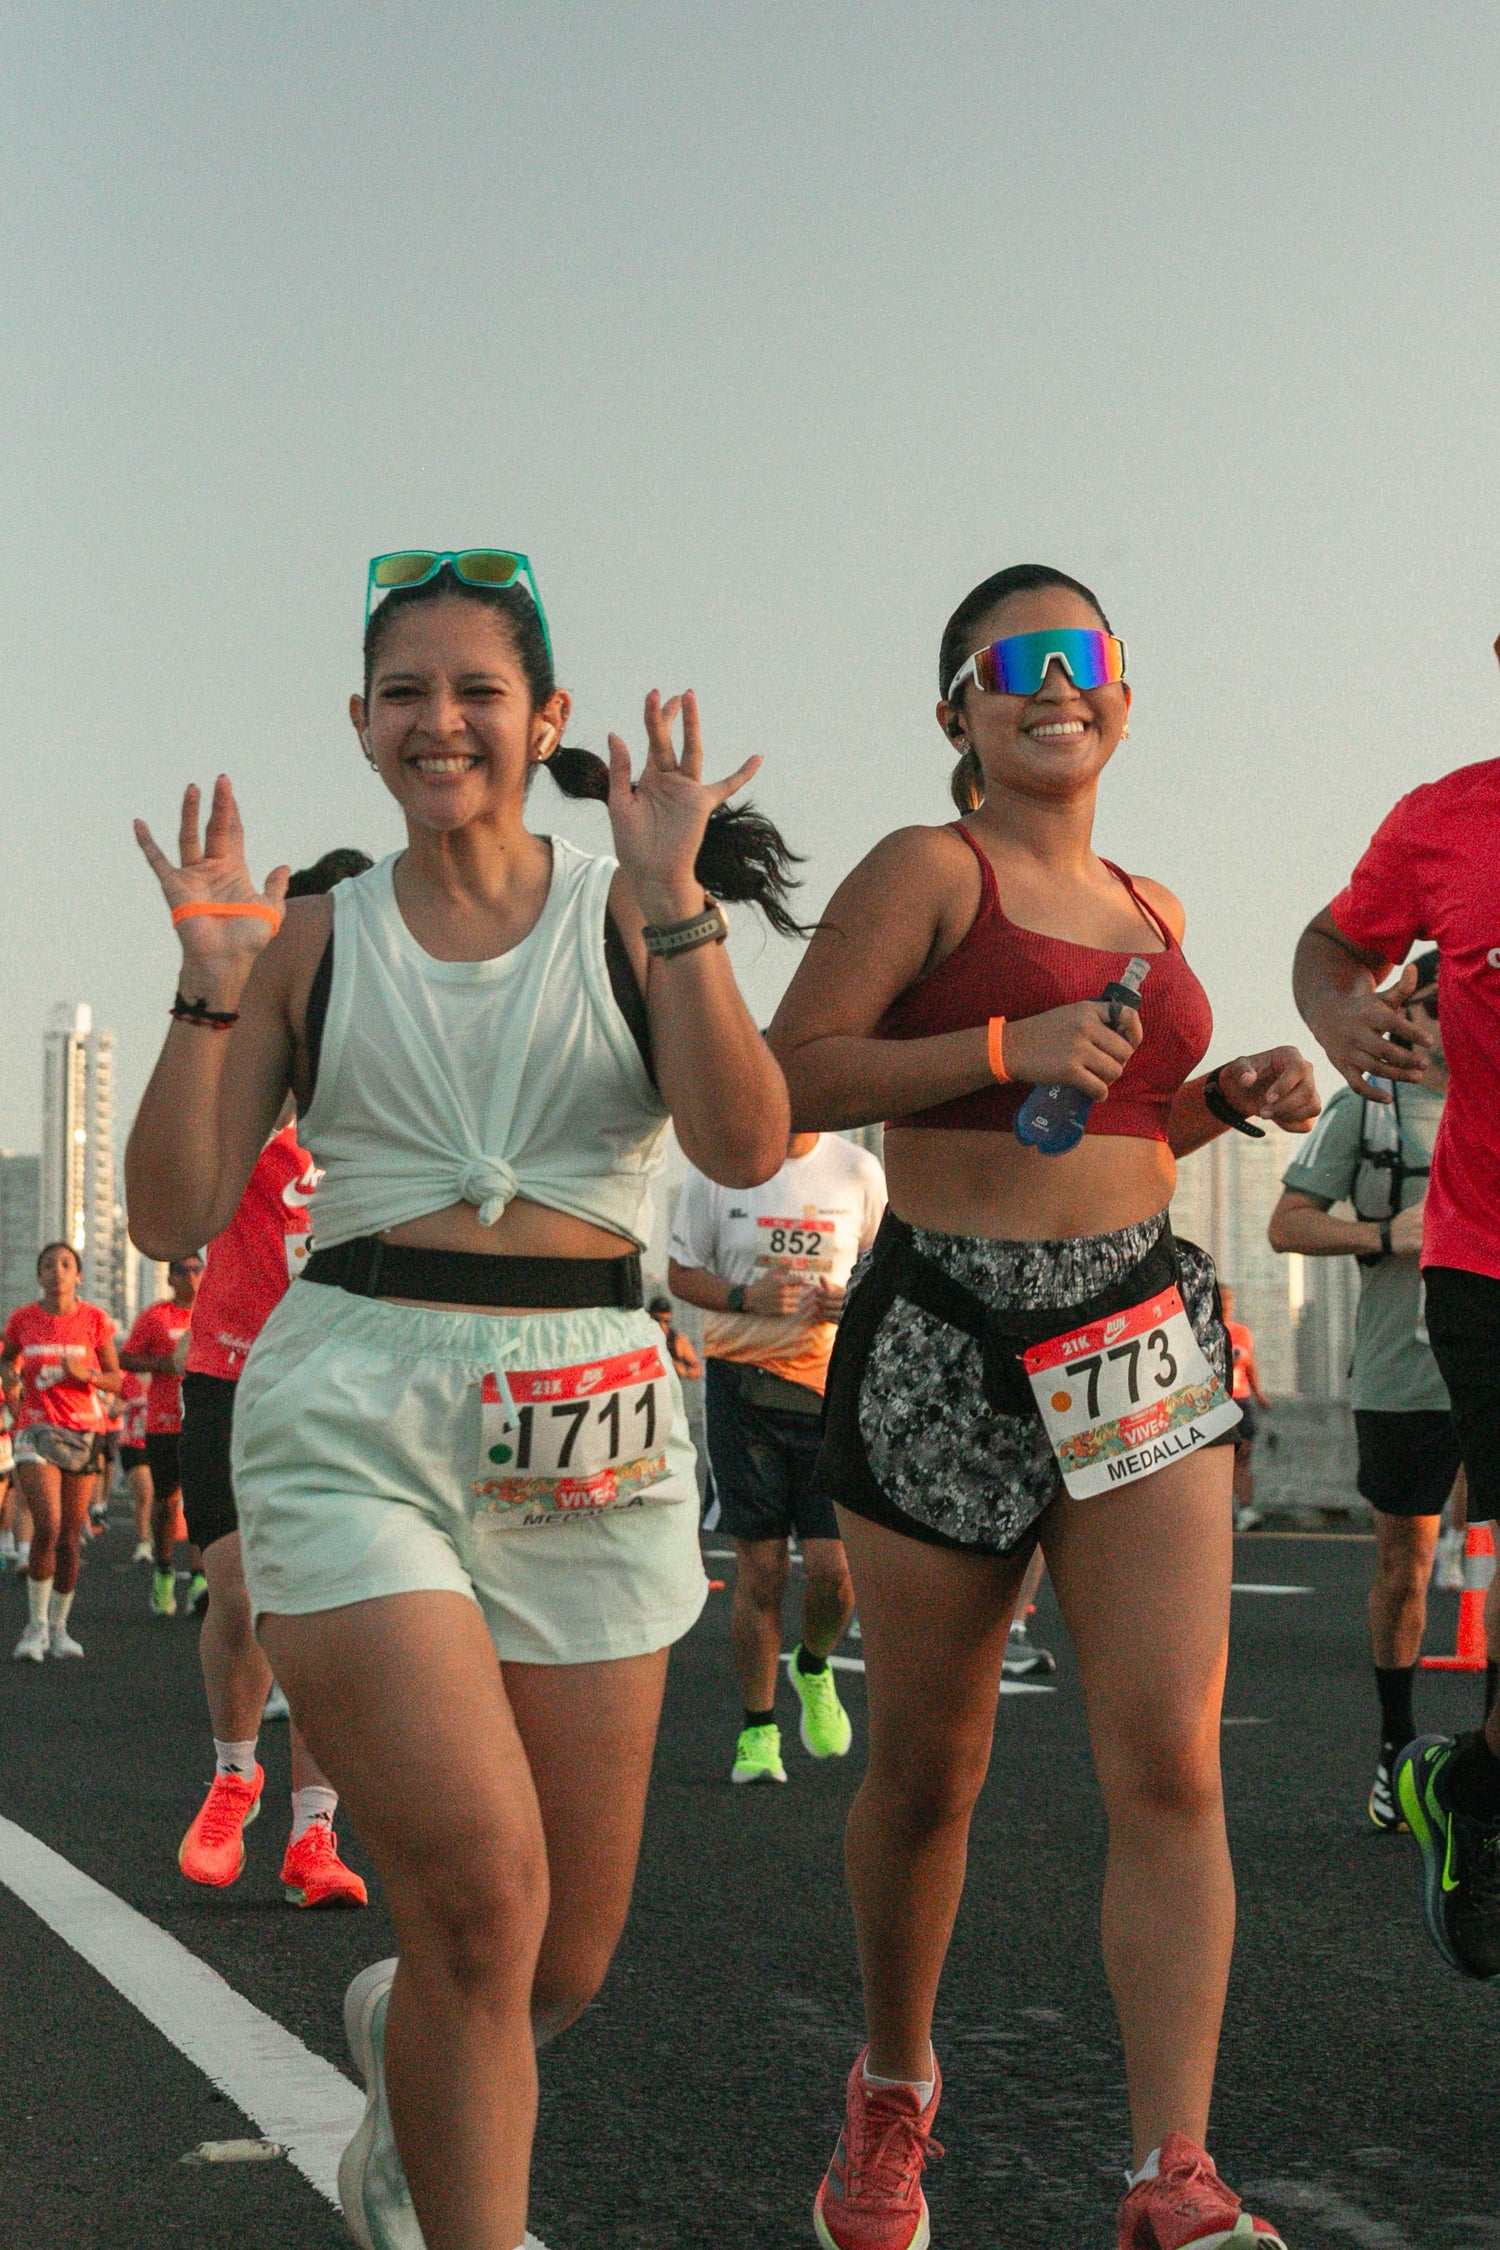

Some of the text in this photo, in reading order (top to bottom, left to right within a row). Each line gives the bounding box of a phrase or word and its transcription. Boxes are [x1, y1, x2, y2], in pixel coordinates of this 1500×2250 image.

[771, 1229, 821, 1255] 852
[1062, 1335, 1090, 1356] 21K
[532, 1379, 562, 1395] 21K
[1065, 1329, 1177, 1419] 773
[503, 1383, 656, 1468] 1711
[1107, 1426, 1206, 1481] MEDALLA
